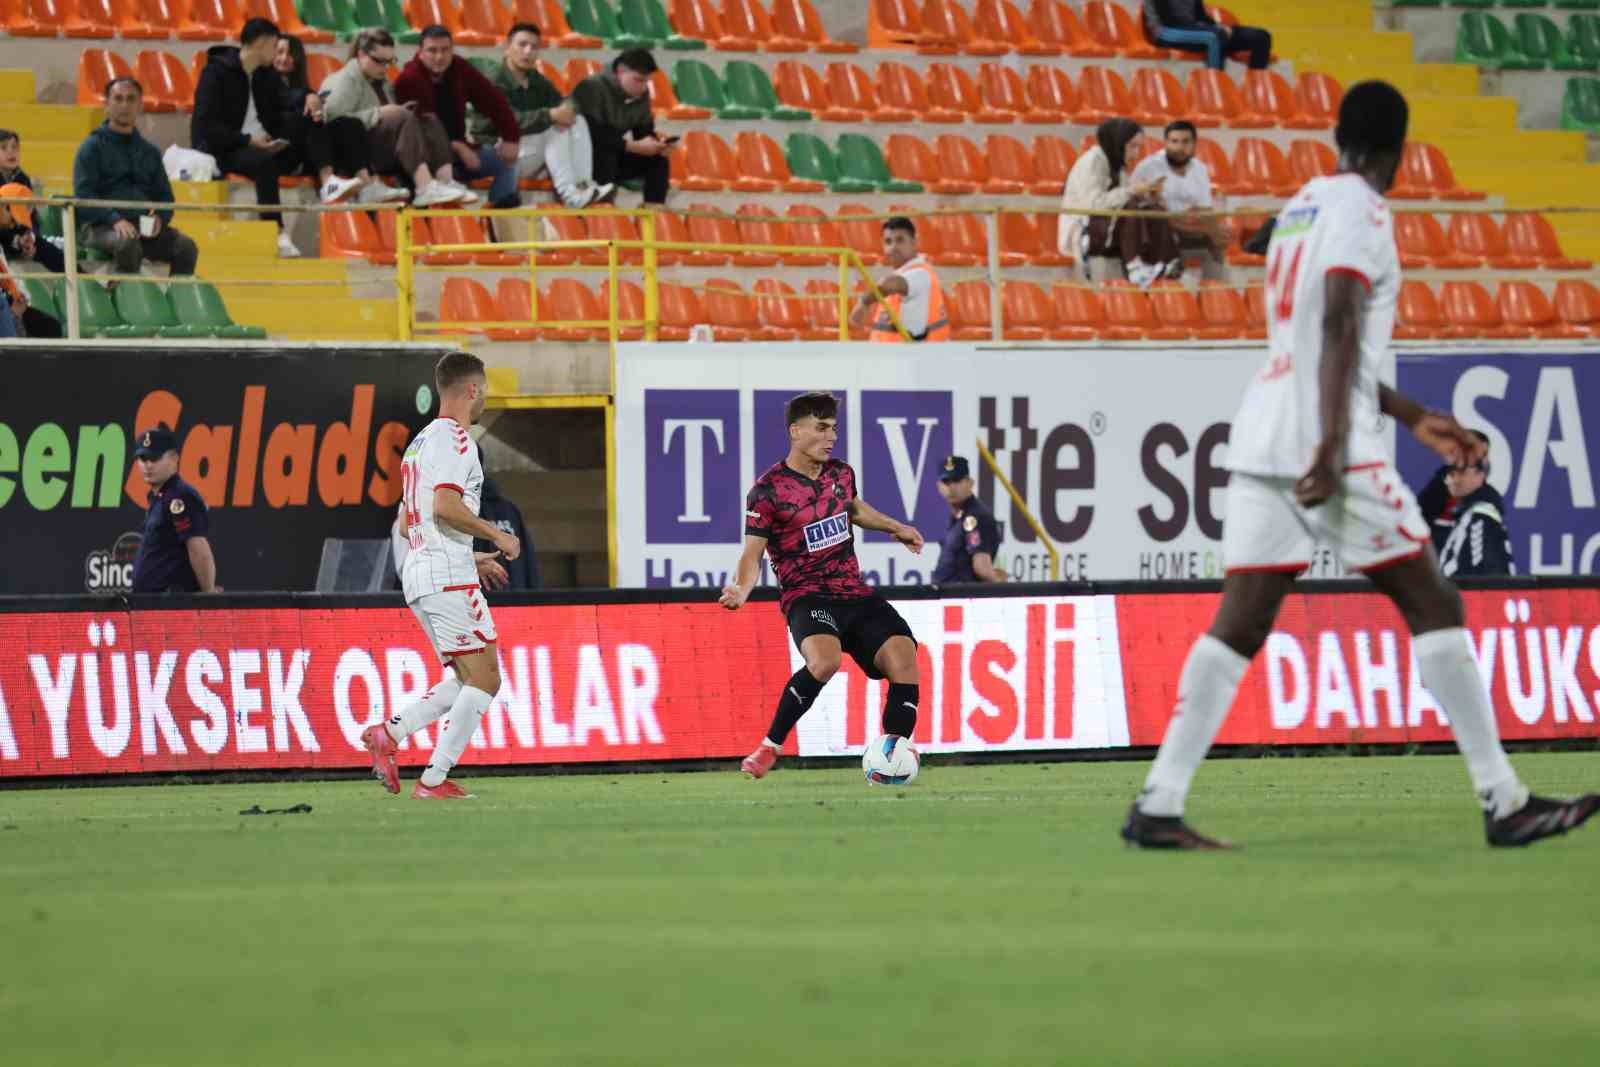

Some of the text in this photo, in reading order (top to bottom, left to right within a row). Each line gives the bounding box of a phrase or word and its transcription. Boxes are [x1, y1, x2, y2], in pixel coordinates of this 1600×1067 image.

[662, 417, 940, 523] TV
[1137, 422, 1233, 542] se
[1452, 365, 1597, 508] SA
[88, 555, 134, 587] Sinc
[1012, 553, 1088, 581] OFFCE
[27, 619, 321, 759] YÜKSEK
[332, 643, 666, 752] ORNLAR
[1463, 599, 1600, 725] YÜK
